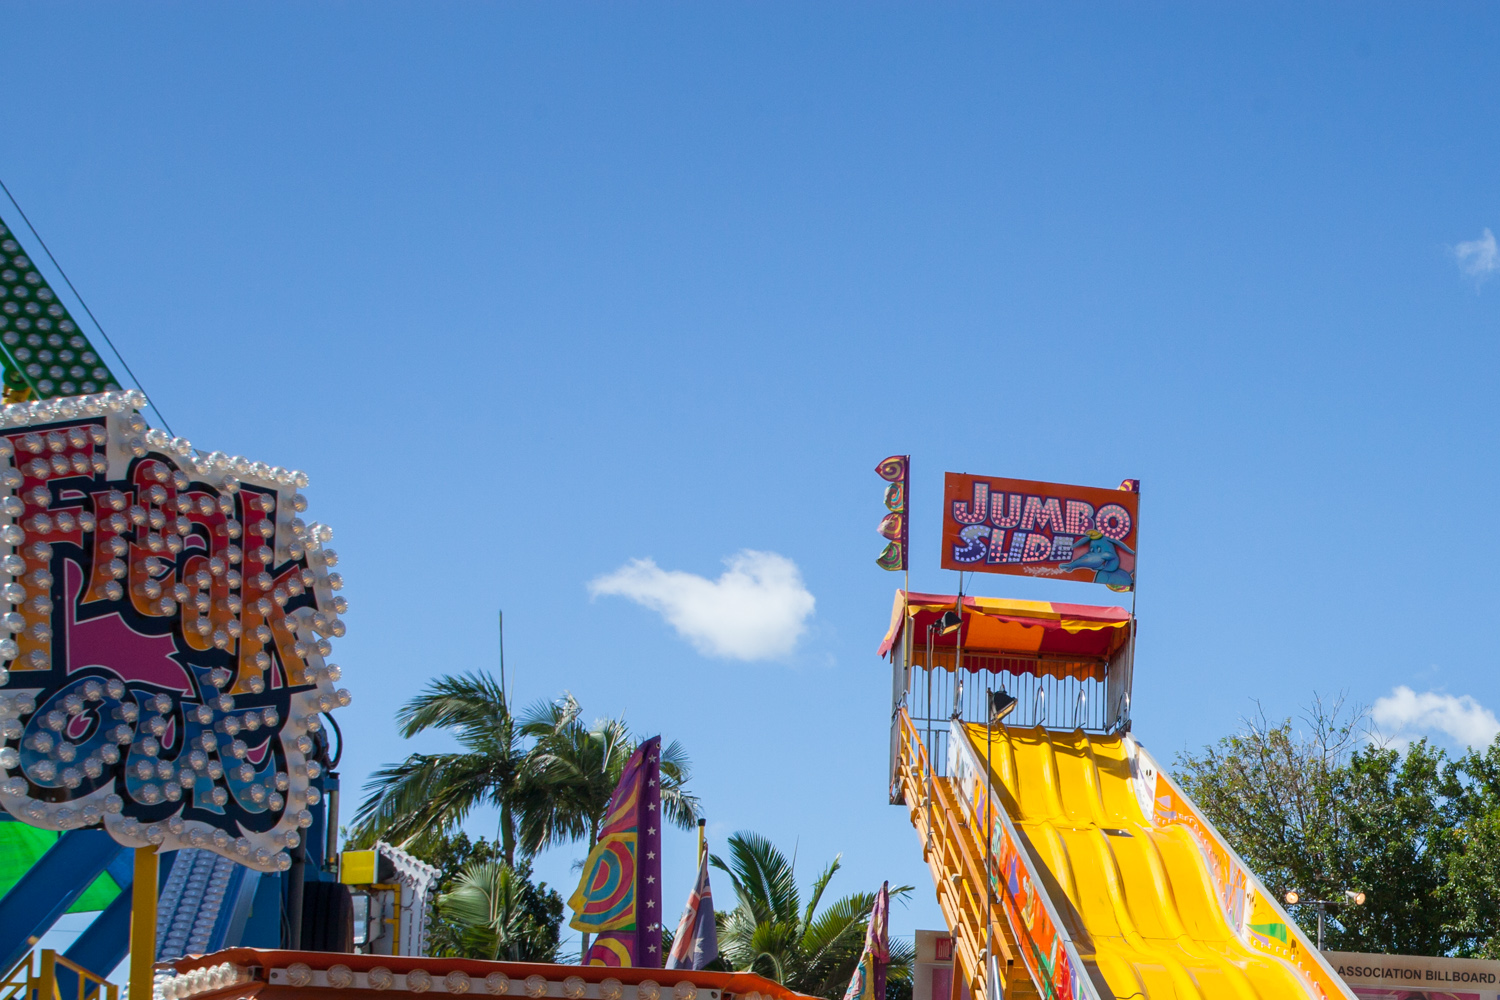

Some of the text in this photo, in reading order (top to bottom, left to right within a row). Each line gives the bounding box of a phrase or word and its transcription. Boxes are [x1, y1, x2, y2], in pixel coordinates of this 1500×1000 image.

[953, 482, 1131, 541] JUMBO
[954, 525, 1074, 564] SLIDE
[1338, 965, 1422, 980] ASSOCIATION
[1425, 970, 1496, 984] BILLBOARD
